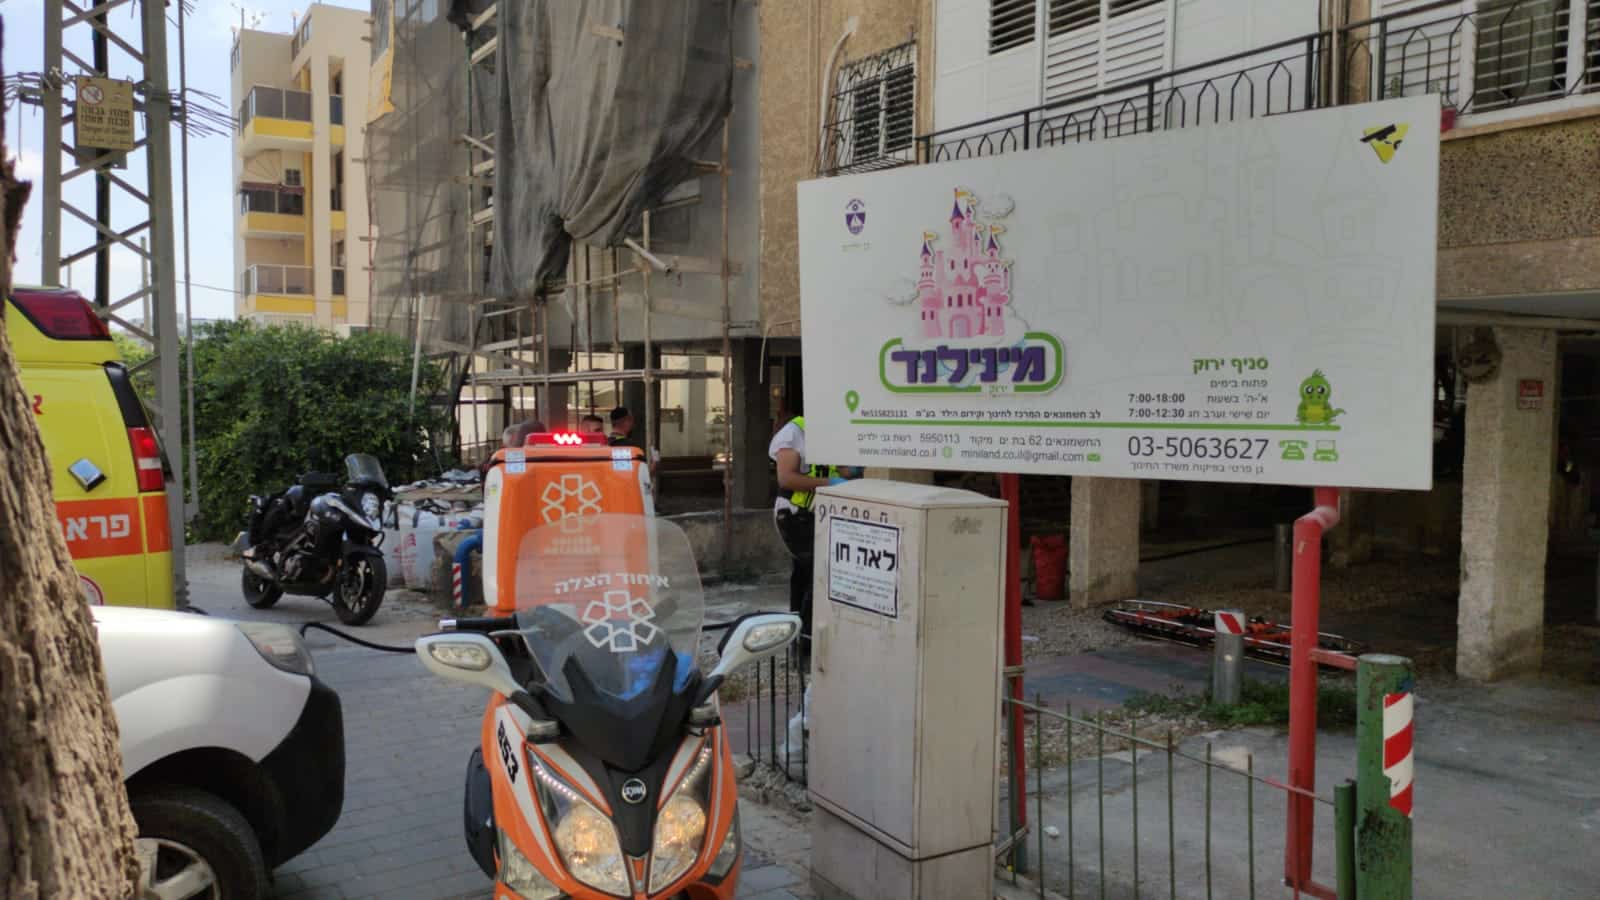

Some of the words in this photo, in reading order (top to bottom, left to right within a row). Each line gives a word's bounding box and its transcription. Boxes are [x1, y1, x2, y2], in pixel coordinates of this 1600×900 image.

[891, 345, 1045, 383] מינילנד
[1192, 358, 1225, 374] ירוק
[1231, 358, 1269, 374] סניף
[1210, 379, 1238, 388] בימים
[1241, 379, 1268, 388] פתוח
[1128, 393, 1185, 403] 7:00-18:00
[1207, 394, 1240, 403] בשעות
[960, 409, 984, 420] וקידום
[986, 408, 1011, 420] לחינוך
[1014, 409, 1041, 419] המרכז
[1043, 410, 1087, 420] חשמונאים
[1089, 408, 1101, 420] לב
[1128, 408, 1185, 418] 7:00-12:30
[1187, 409, 1200, 418] חג
[1203, 409, 1226, 418] וערב
[1229, 409, 1253, 418] שישי
[1256, 410, 1271, 419] יום
[857, 432, 878, 441] ילדים
[893, 433, 912, 442] רשת
[969, 435, 993, 447] מיקוד
[999, 436, 1009, 445] ים
[1012, 436, 1026, 446] בת
[1029, 435, 1042, 446] 62
[1045, 437, 1101, 447] החשמונאים
[1128, 436, 1269, 460] 03-5063627
[1130, 461, 1160, 472] החינוך
[1164, 462, 1190, 472] משרד
[1193, 462, 1226, 474] בפיקוח
[1228, 463, 1253, 473] פרטי
[58, 514, 130, 541] פרא
[857, 546, 896, 571] לאה
[554, 574, 611, 594] הצלה
[616, 573, 670, 588] איחוד
